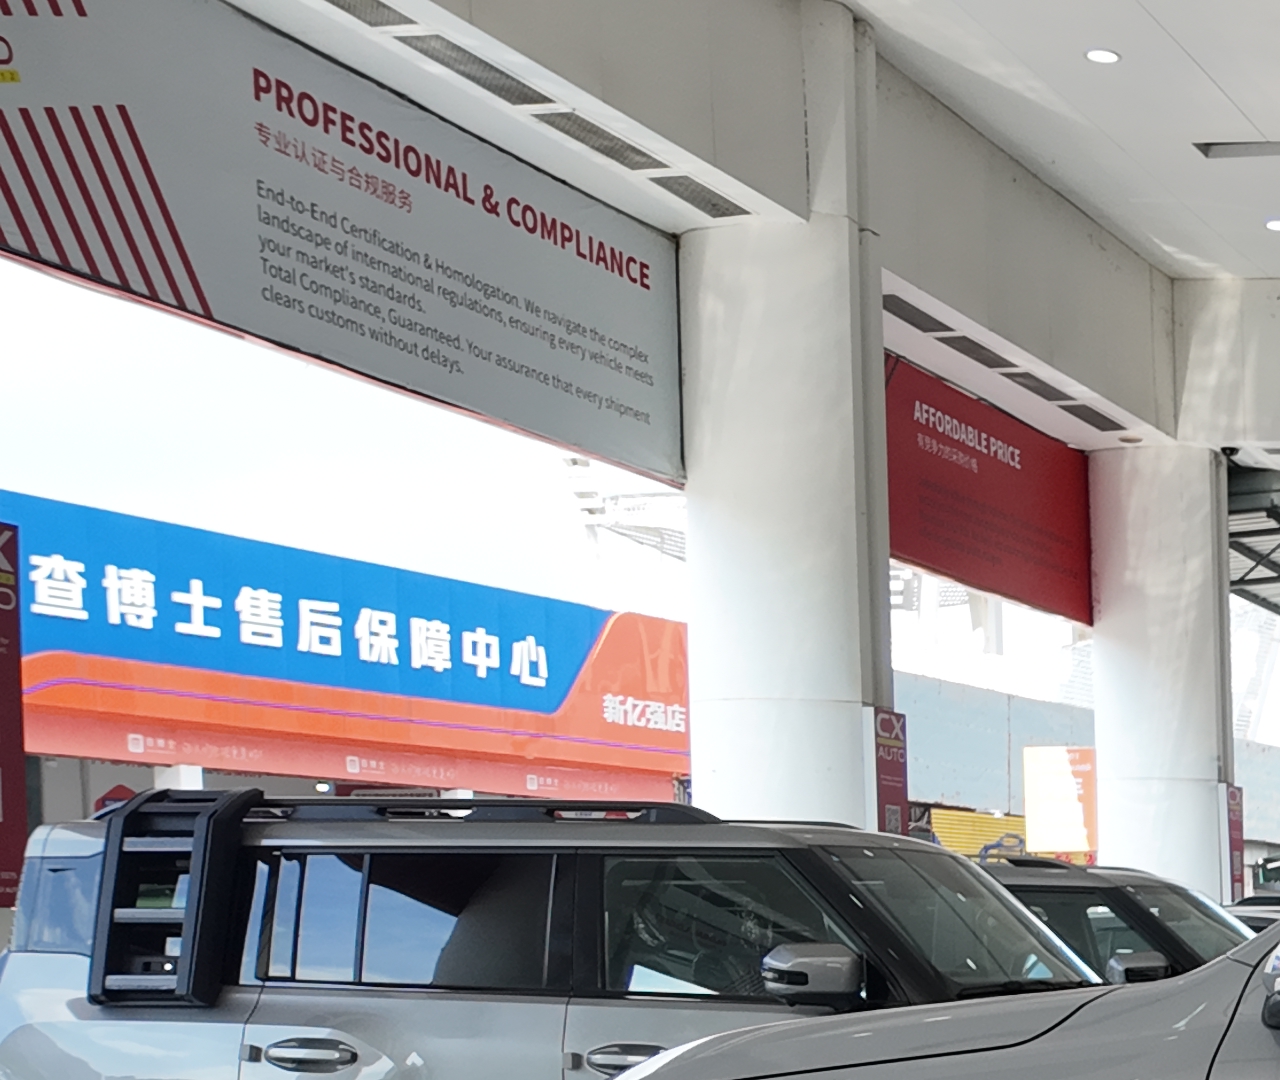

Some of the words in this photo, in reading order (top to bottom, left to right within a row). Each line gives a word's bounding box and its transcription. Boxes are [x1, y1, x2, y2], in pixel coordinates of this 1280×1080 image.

[253, 67, 475, 206] PROFESSIONAL
[482, 184, 500, 217] &
[506, 197, 651, 290] COMPLIANCE
[254, 121, 412, 211] 专业认证与合规服务
[256, 179, 337, 229] End-to-End
[341, 216, 421, 265] Certification
[423, 254, 433, 270] &
[435, 258, 522, 310] Homologation.
[524, 297, 541, 318] We
[543, 308, 588, 338] navigate
[590, 327, 606, 346] the
[608, 336, 649, 364] complex
[257, 204, 331, 250] landscape
[334, 240, 349, 257] of
[351, 244, 434, 295] international
[437, 284, 507, 328] regulations,
[509, 316, 556, 350] ensuring
[558, 338, 587, 361] every
[589, 351, 623, 374] vehicle
[625, 365, 654, 387] meets
[258, 234, 291, 258] your
[296, 250, 355, 285] market's
[359, 275, 426, 314] standards.
[260, 257, 296, 286] Total
[300, 273, 386, 324] Compliance,
[388, 309, 464, 352] Guaranteed.
[465, 339, 493, 362] Your
[495, 354, 550, 386] assurance
[552, 374, 574, 396] that
[575, 386, 603, 410] every
[605, 395, 651, 425] shipment
[261, 285, 305, 314] clears
[308, 303, 366, 337] customs
[368, 326, 420, 362] without
[422, 346, 464, 375] delays.
[914, 400, 988, 454] AFFORDABLE
[990, 436, 1021, 470] PRICE
[29, 553, 550, 688] 查博士售后保障中心
[602, 693, 686, 733] 新亿强店
[876, 713, 904, 740] CX
[878, 746, 905, 763] AUTO
